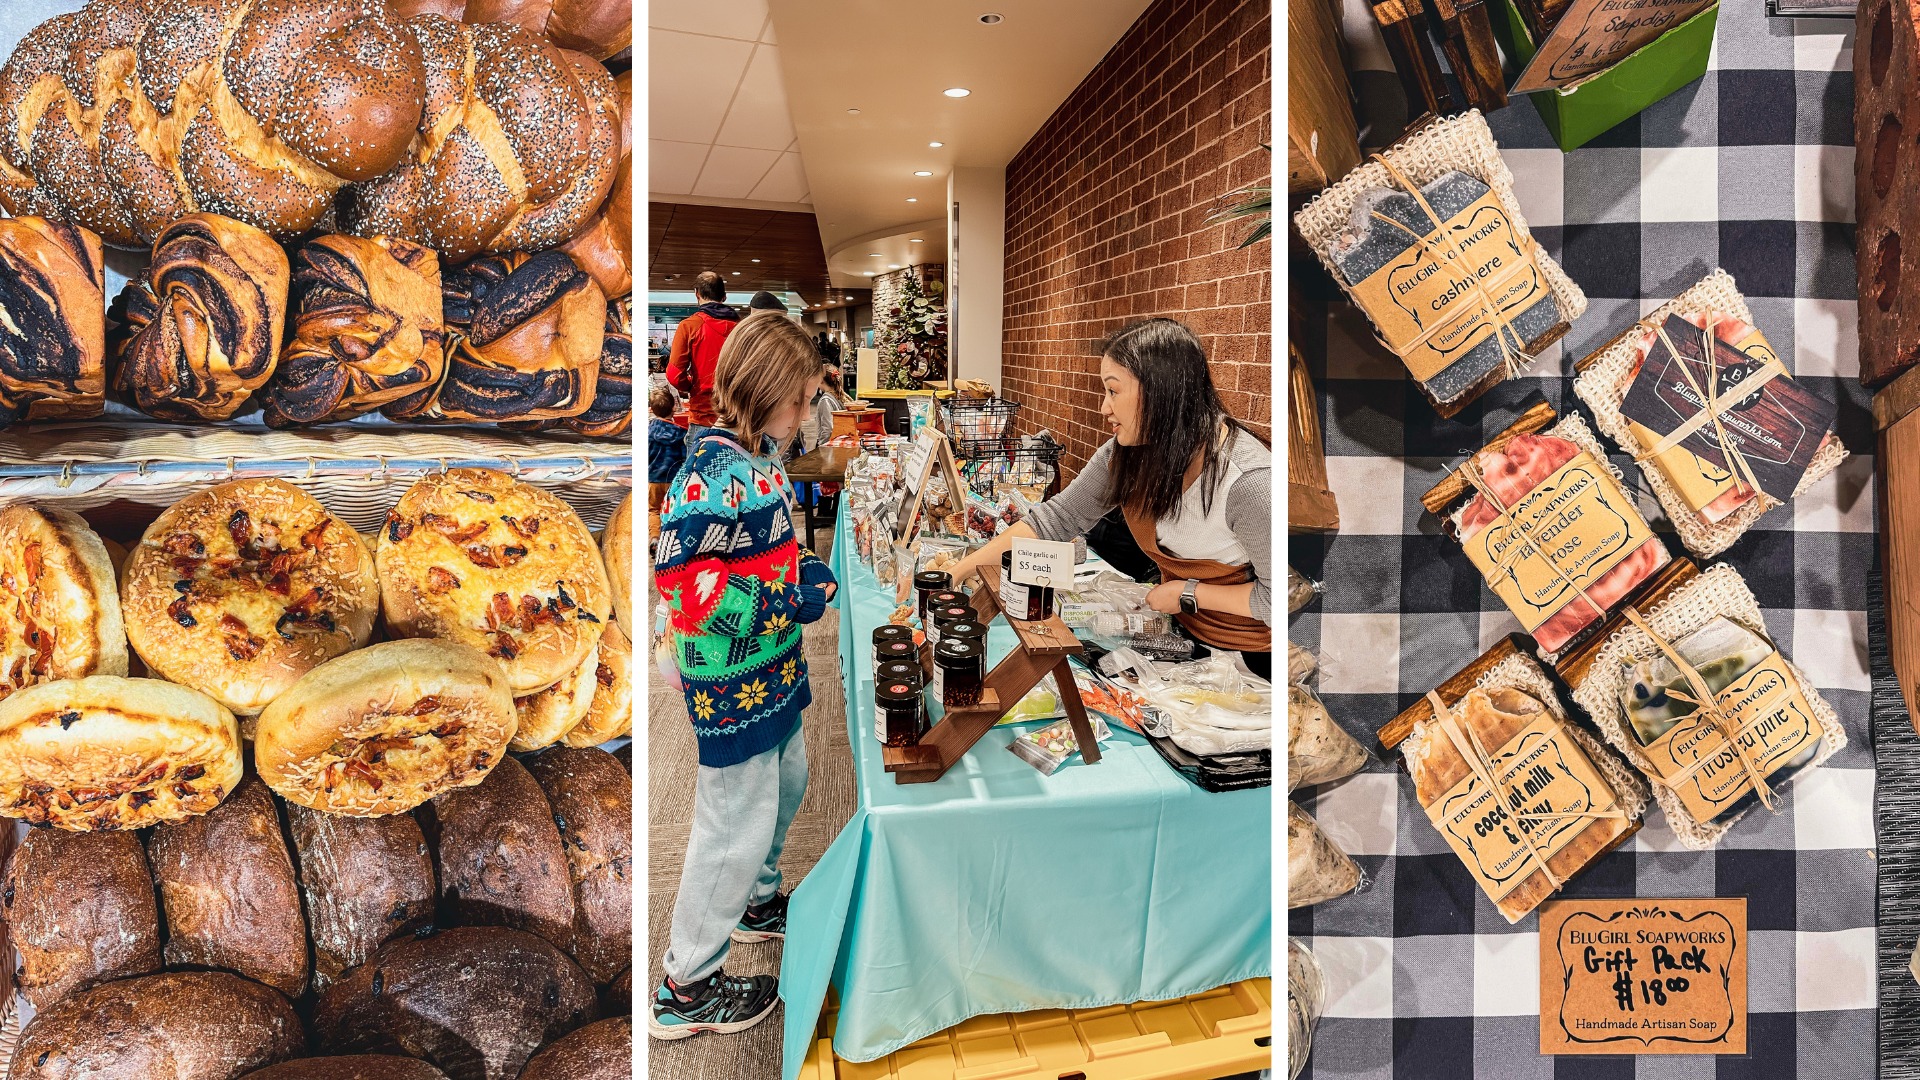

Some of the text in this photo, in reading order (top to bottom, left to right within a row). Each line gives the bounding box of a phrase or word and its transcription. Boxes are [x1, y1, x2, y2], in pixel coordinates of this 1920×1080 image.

[1604, 10, 1676, 39] Soap dish
[1509, 279, 1529, 299] Soap
[1017, 549, 1033, 557] Chile
[1033, 551, 1048, 559] garlic
[1550, 533, 1582, 565] rose
[1019, 560, 1052, 573] $5 each
[1535, 530, 1621, 600] Handmde Artisan Soap
[1721, 677, 1778, 724] OAPWORKS
[1753, 740, 1782, 765] Artisan
[1781, 729, 1801, 746] Soap
[1524, 764, 1556, 799] milk
[1503, 824, 1520, 846] &
[1570, 930, 1726, 945] BLUGIRL SOAPWORKS
[1583, 945, 1711, 975] Gift Pack
[1575, 1018, 1718, 1033] Handmade Artisan Soap
